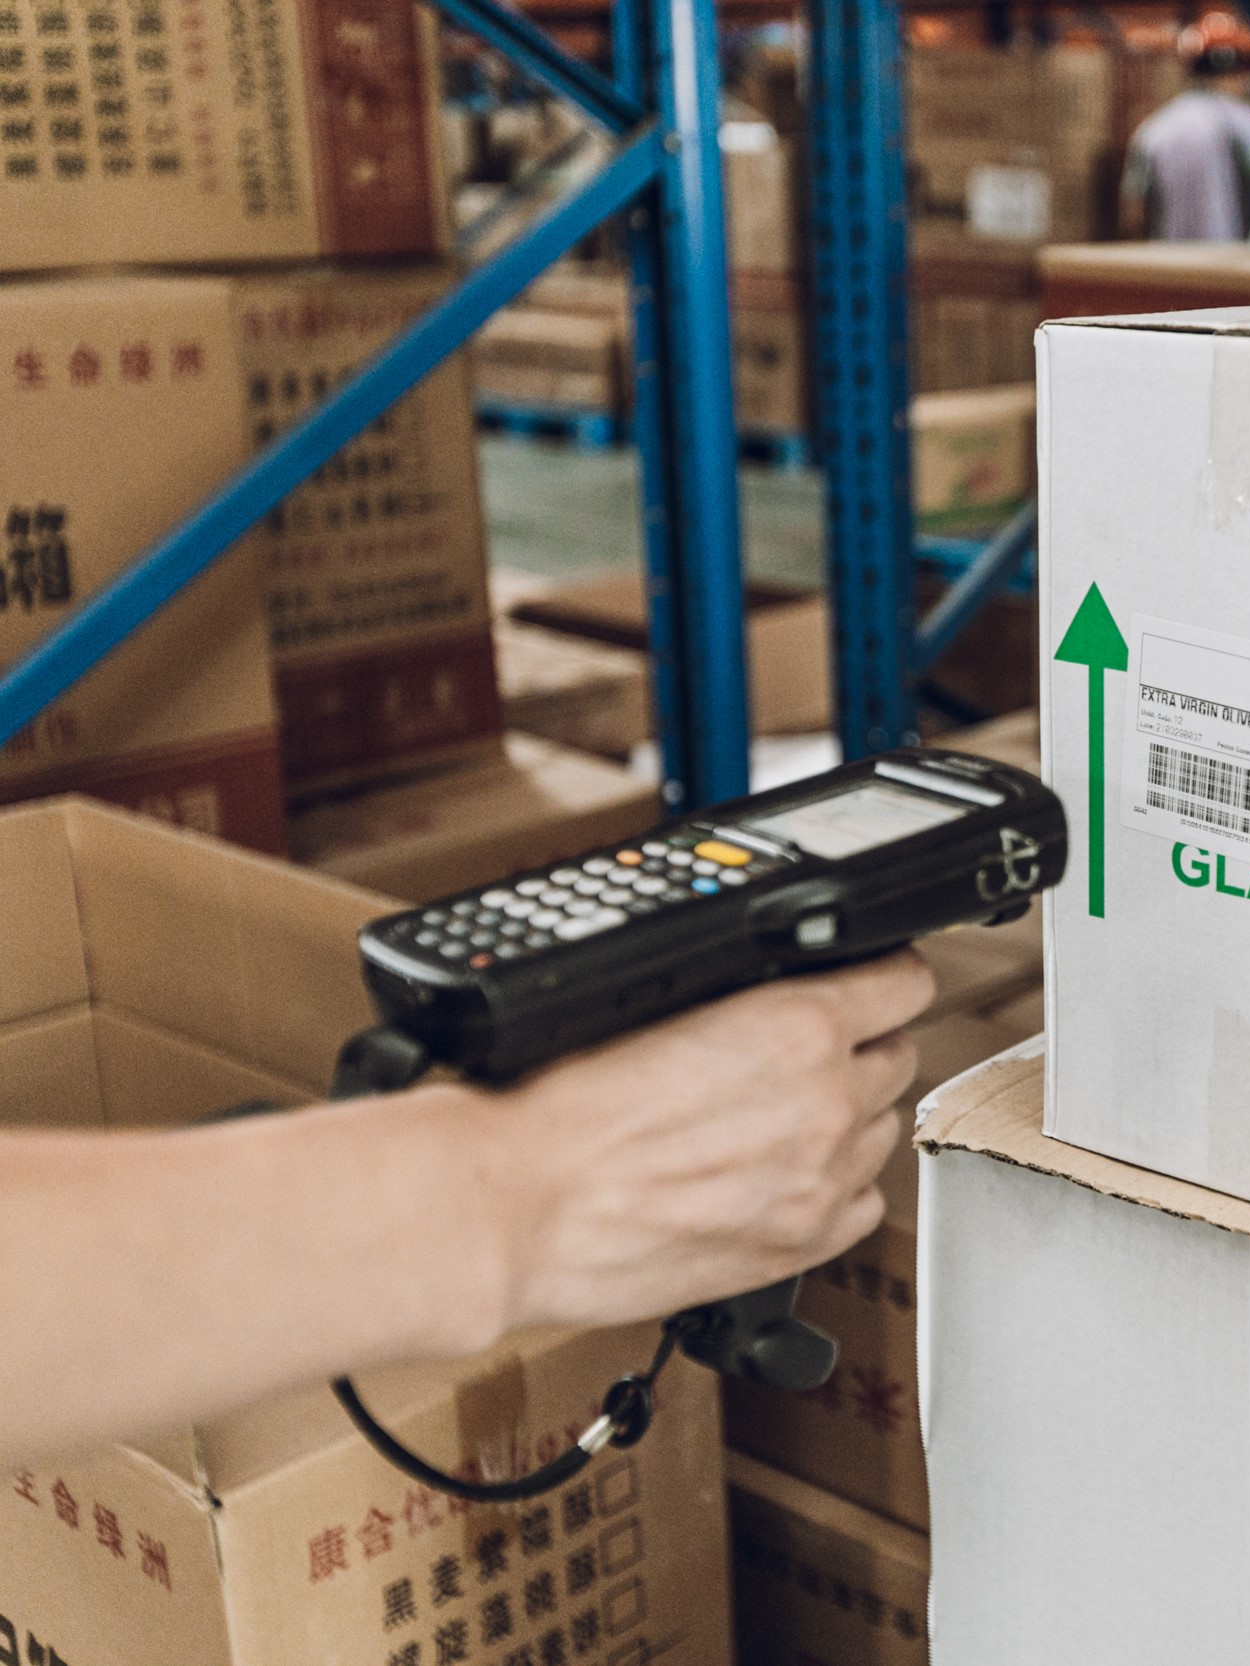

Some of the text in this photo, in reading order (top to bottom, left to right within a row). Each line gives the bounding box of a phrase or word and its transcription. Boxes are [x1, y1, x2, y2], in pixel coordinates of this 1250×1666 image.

[1141, 686, 1176, 708] EXTRA
[1180, 695, 1218, 718] VIRGIN
[13, 1464, 172, 1592] 生命绿洲
